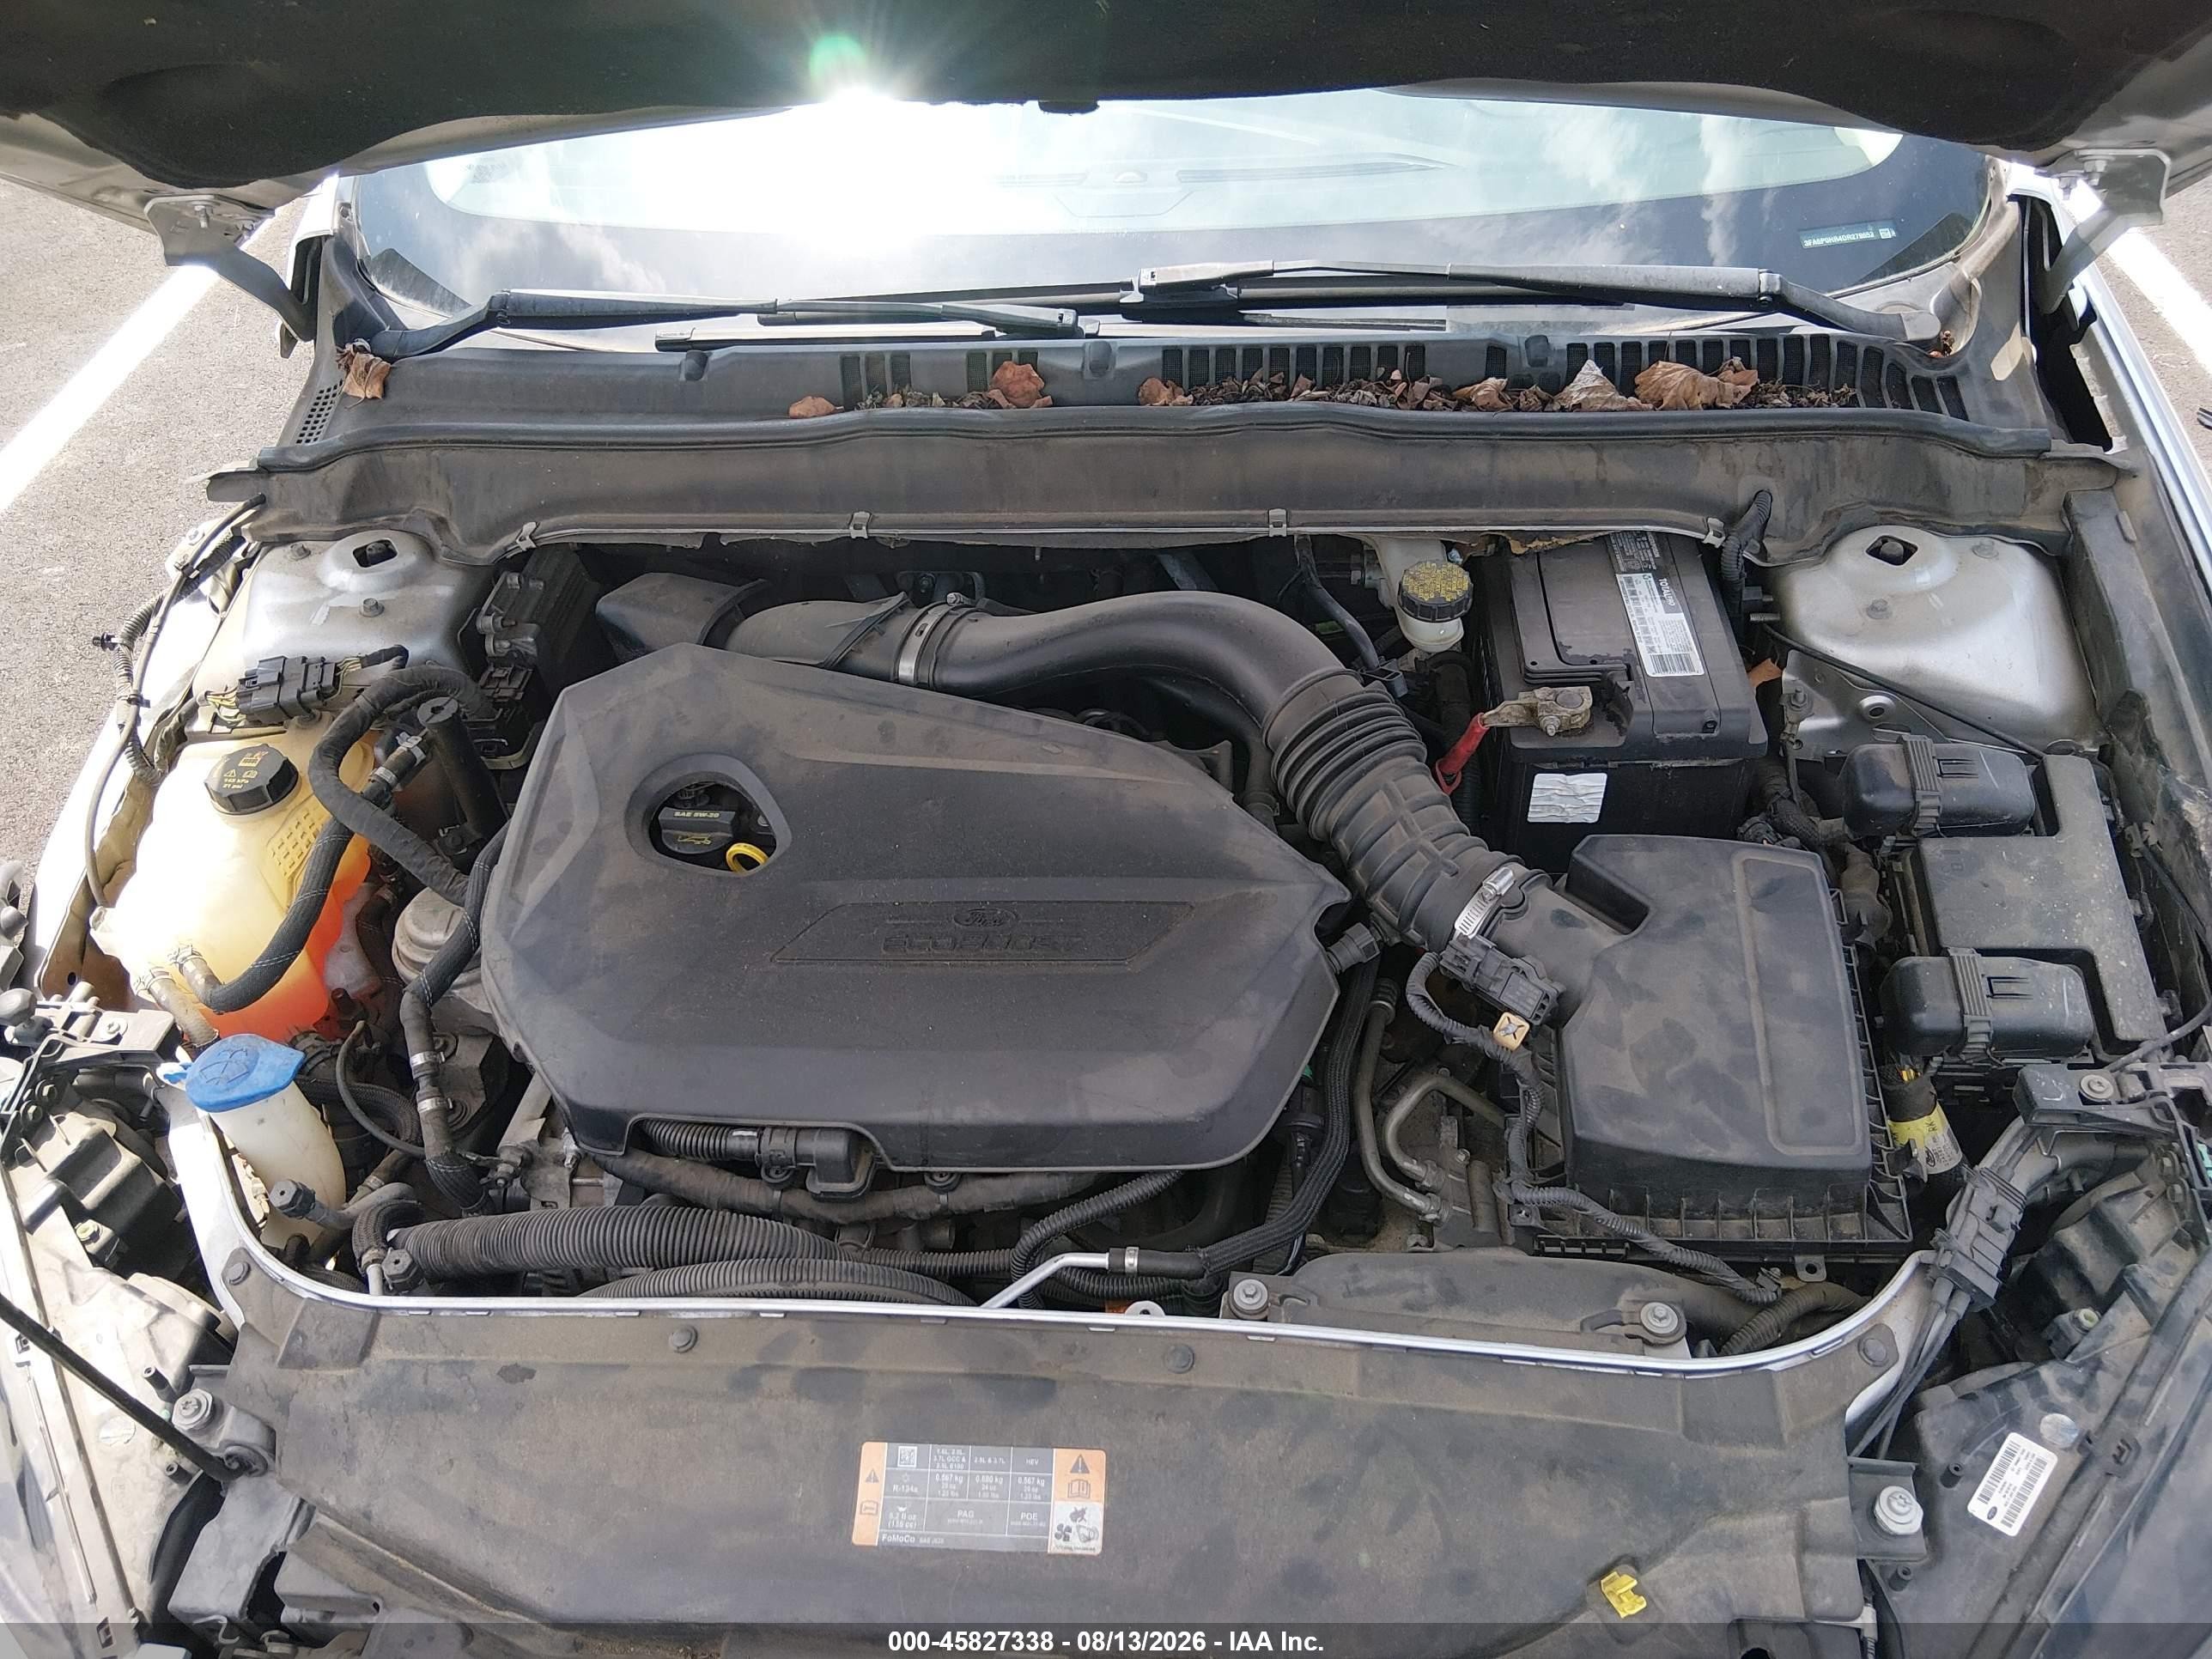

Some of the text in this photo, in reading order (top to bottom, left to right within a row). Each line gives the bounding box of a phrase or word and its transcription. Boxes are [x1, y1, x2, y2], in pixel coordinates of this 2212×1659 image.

[1036, 1477, 1045, 1487] kg
[957, 1510, 975, 1518] PAG
[1020, 1511, 1038, 1520] POE
[881, 1534, 915, 1542] FoMoCo
